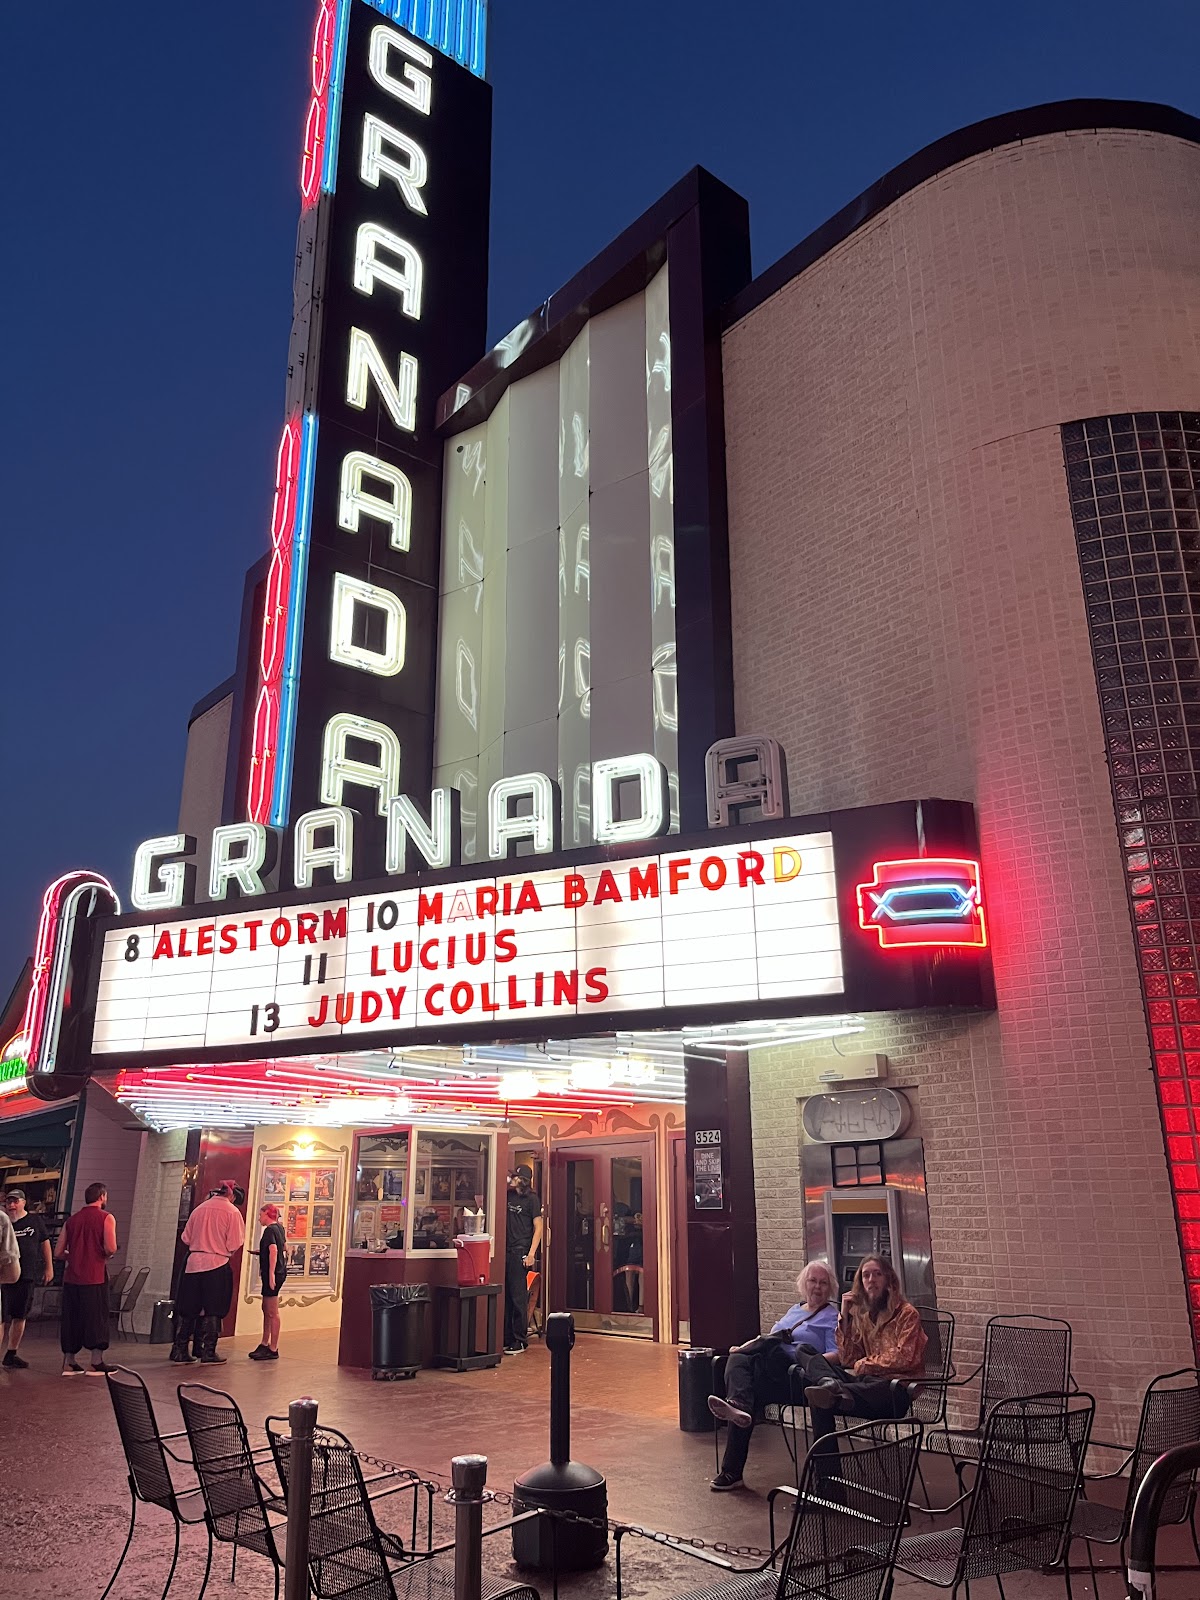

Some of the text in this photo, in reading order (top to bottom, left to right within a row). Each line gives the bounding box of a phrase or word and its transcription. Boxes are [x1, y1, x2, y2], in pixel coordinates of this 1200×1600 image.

[319, 24, 434, 817] GRANADA
[131, 734, 788, 911] GRANADA
[124, 844, 803, 963] 8 ALESTORM 10 MARIA BAMFORD
[249, 966, 610, 1036] 13 JUDY COLLINS
[302, 928, 518, 986] 11 LUCIUS
[696, 1131, 720, 1143] 3524
